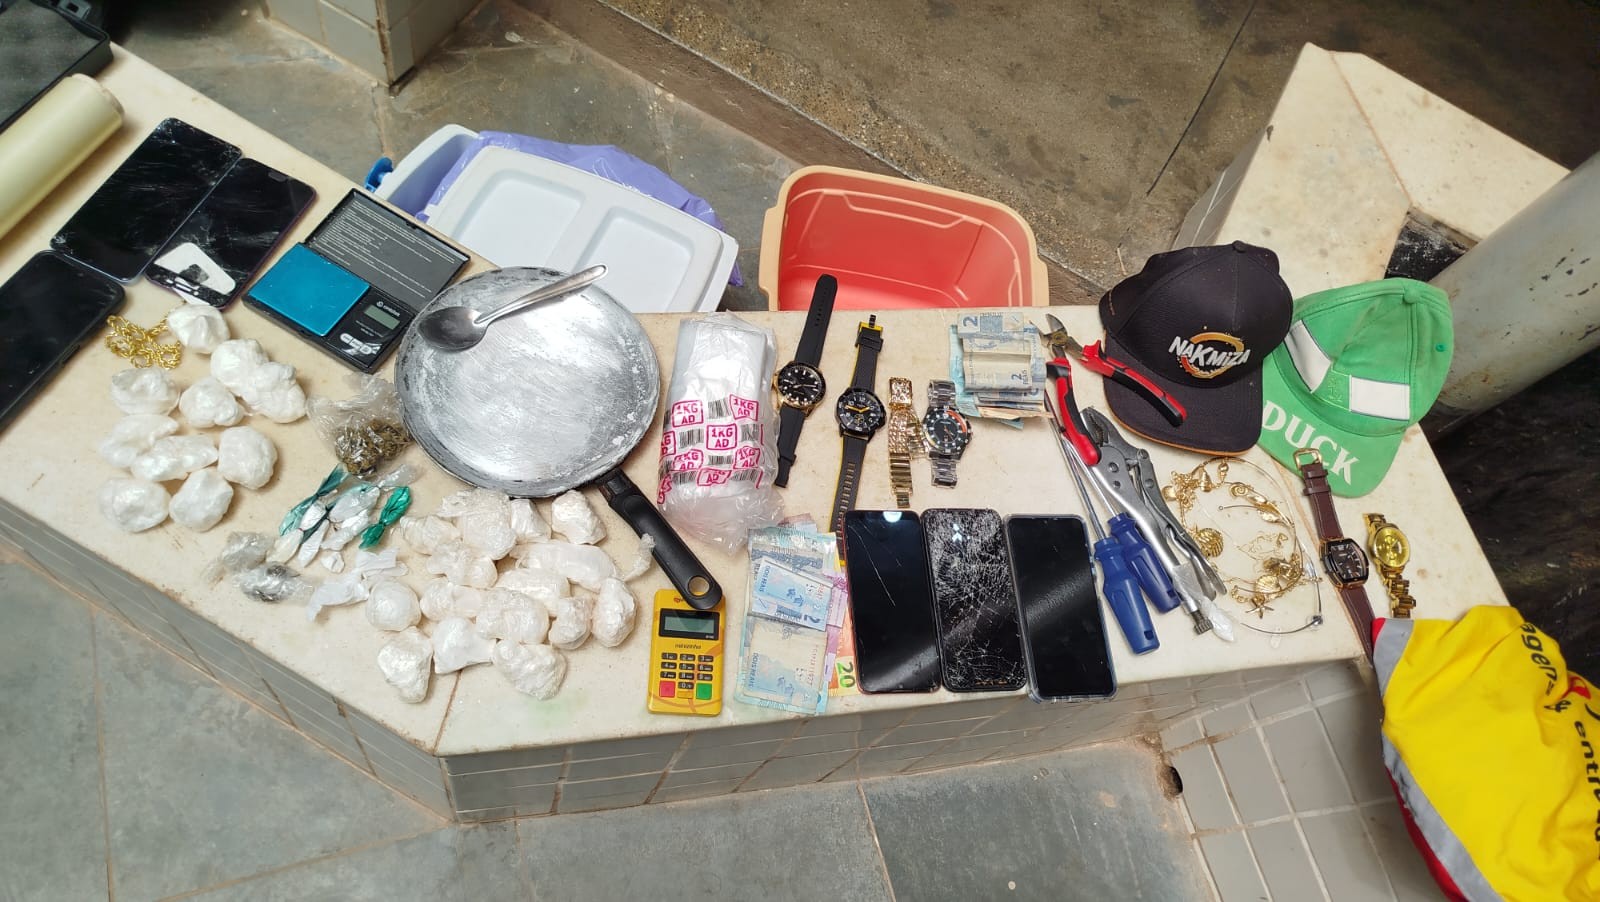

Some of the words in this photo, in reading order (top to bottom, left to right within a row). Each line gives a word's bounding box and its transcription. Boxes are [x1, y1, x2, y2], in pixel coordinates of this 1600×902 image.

[733, 398, 755, 410] 1KG
[737, 408, 751, 417] AD
[681, 415, 696, 425] AD
[711, 427, 733, 438] 1KG
[715, 439, 729, 448] AD
[1262, 400, 1360, 486] DUCK
[706, 474, 719, 483] AD
[837, 662, 856, 688] 20
